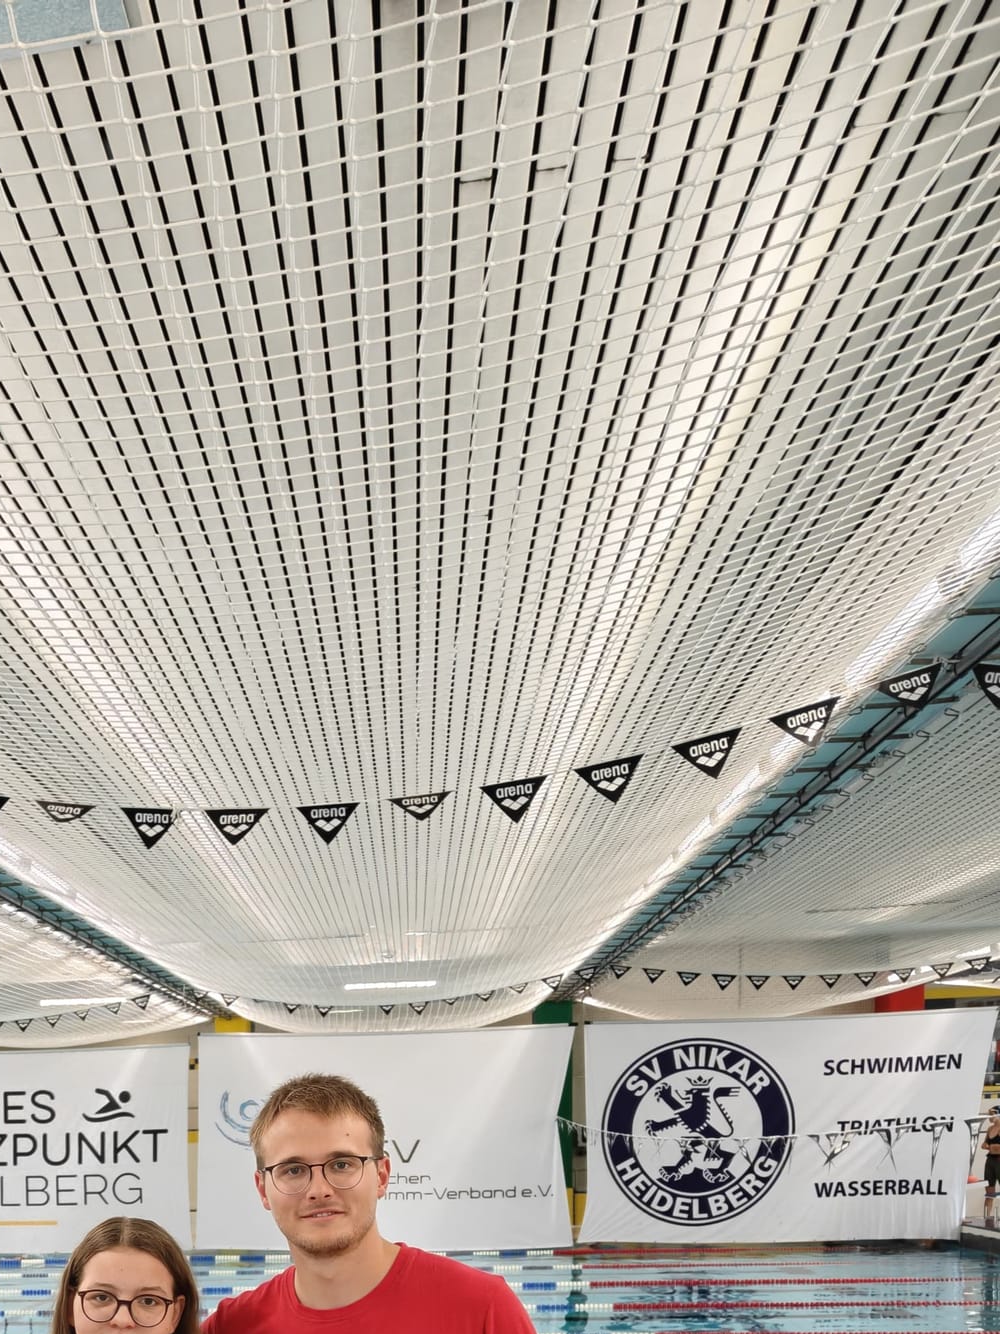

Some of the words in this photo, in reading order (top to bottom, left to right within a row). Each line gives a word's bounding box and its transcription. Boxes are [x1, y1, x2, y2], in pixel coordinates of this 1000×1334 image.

[889, 673, 931, 694] arena
[787, 706, 827, 729] arena
[689, 737, 729, 757] arena
[591, 762, 629, 781] arena
[402, 795, 438, 806] arena
[495, 783, 533, 799] arena
[47, 803, 81, 815] arena
[135, 812, 169, 825] arena
[219, 812, 254, 825] arena
[311, 806, 346, 819] arena
[626, 1061, 661, 1097] SV
[672, 1045, 772, 1096] NIKAR
[823, 1053, 963, 1076] SCHWIMMEN
[384, 1186, 516, 1200] imm-Verband
[521, 1184, 554, 1198] e.V.
[615, 1155, 779, 1220] HEIDELBERG
[815, 1179, 947, 1198] WASSERBALL
